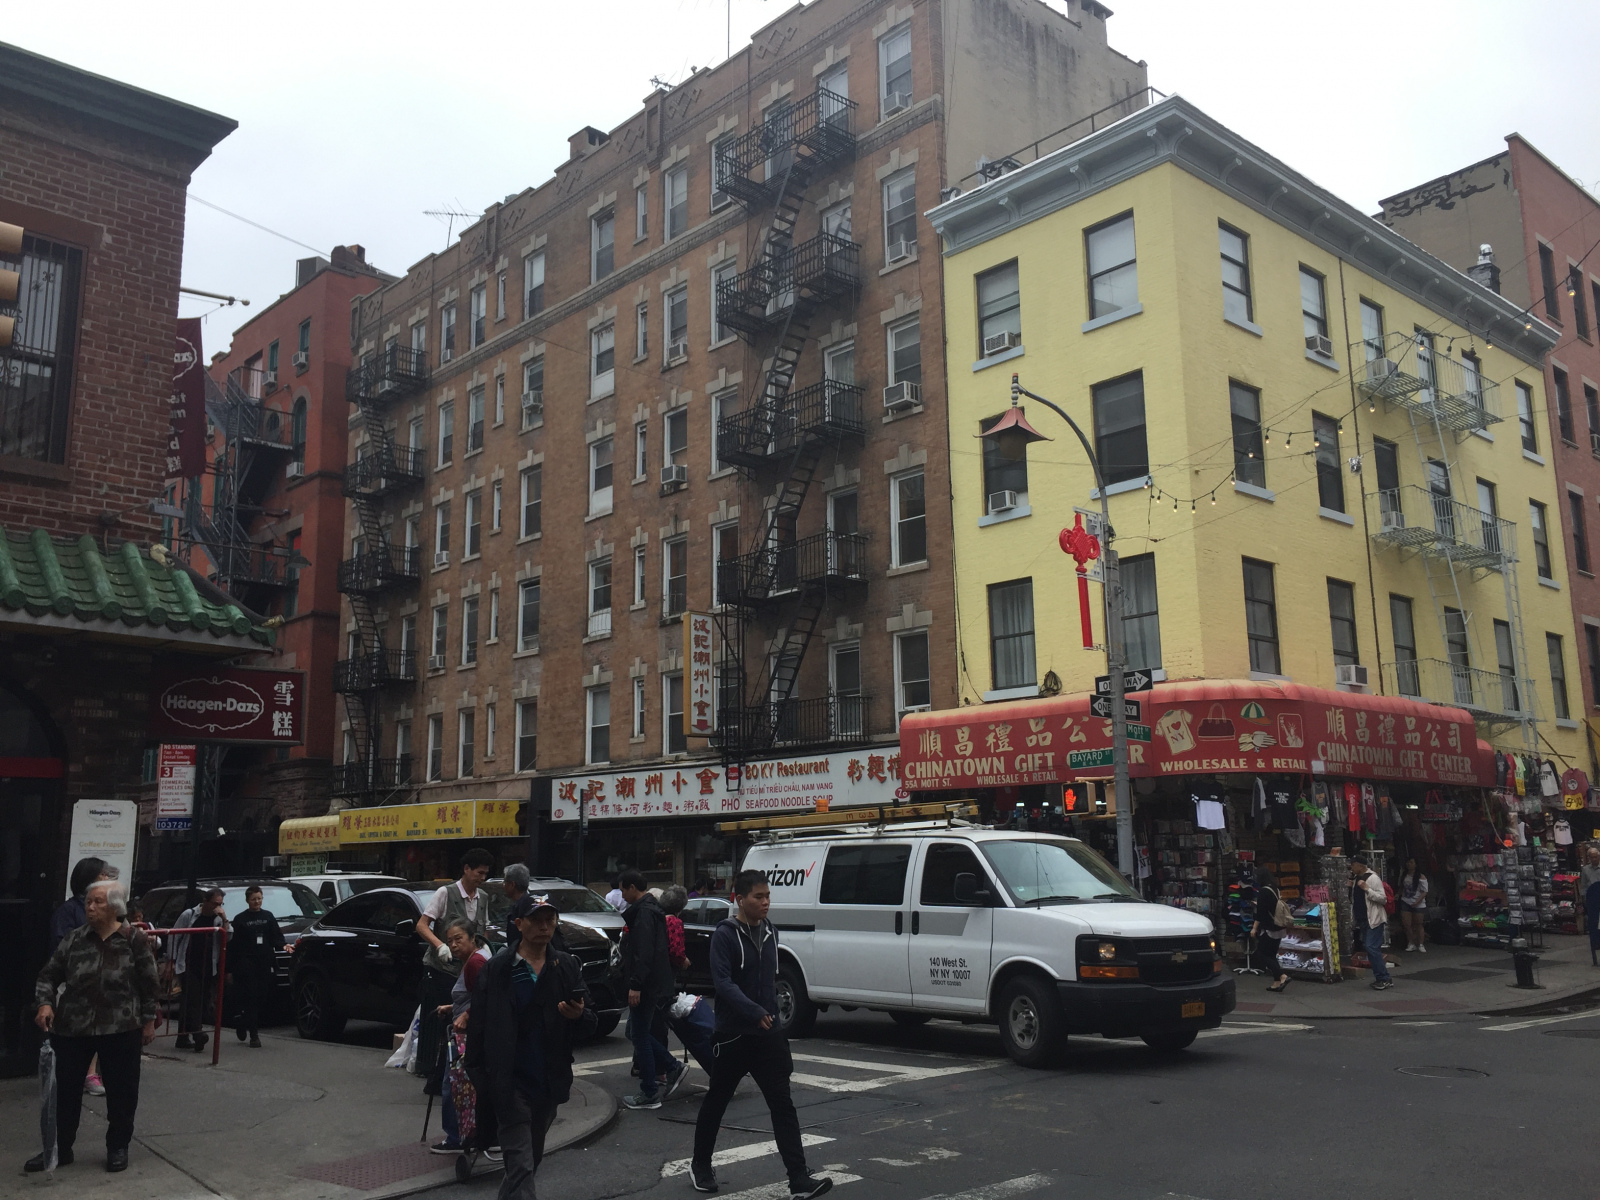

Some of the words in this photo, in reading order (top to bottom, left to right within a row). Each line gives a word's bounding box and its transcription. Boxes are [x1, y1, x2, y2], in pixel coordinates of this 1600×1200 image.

[1126, 676, 1144, 687] WAY
[167, 695, 261, 714] Häagen-Dazs
[272, 680, 295, 737] 雪糕
[1097, 702, 1112, 713] ONE
[1124, 704, 1134, 715] AY
[1128, 724, 1144, 735] Mott
[1326, 707, 1462, 755] 順昌禮品公司
[1071, 752, 1103, 763] BAYARD
[1317, 741, 1394, 767] CHINATOWN
[1399, 750, 1425, 769] GIFT
[1430, 752, 1472, 774] CENTER
[163, 767, 170, 777] 3
[745, 764, 758, 780] BO
[760, 762, 774, 779] KY
[777, 757, 830, 778] Restaurant
[904, 756, 1005, 779] CHINATOWN
[1014, 752, 1056, 772] GIFT
[1160, 759, 1248, 773] WHOLESALE
[1256, 758, 1266, 769] &
[1272, 758, 1308, 770] RETAIL
[1326, 763, 1343, 773] MOTT
[1372, 766, 1404, 778] WHOLESALE
[802, 783, 815, 791] NAM
[816, 782, 834, 790] VANG
[904, 780, 918, 789] 55A
[920, 778, 940, 789] MOTT
[976, 773, 1019, 786] WHOLESALE
[1023, 773, 1029, 783] &
[1032, 771, 1058, 782] RETAIL
[745, 797, 779, 810] SEAFOOD
[781, 796, 811, 808] NOODLE
[103, 841, 126, 849] Frappe
[767, 864, 805, 886] rizon
[930, 957, 940, 967] 140
[941, 957, 958, 968] West
[958, 958, 968, 968] St.
[930, 969, 939, 978] NY
[941, 969, 950, 979] NY
[952, 970, 971, 980] 10007
